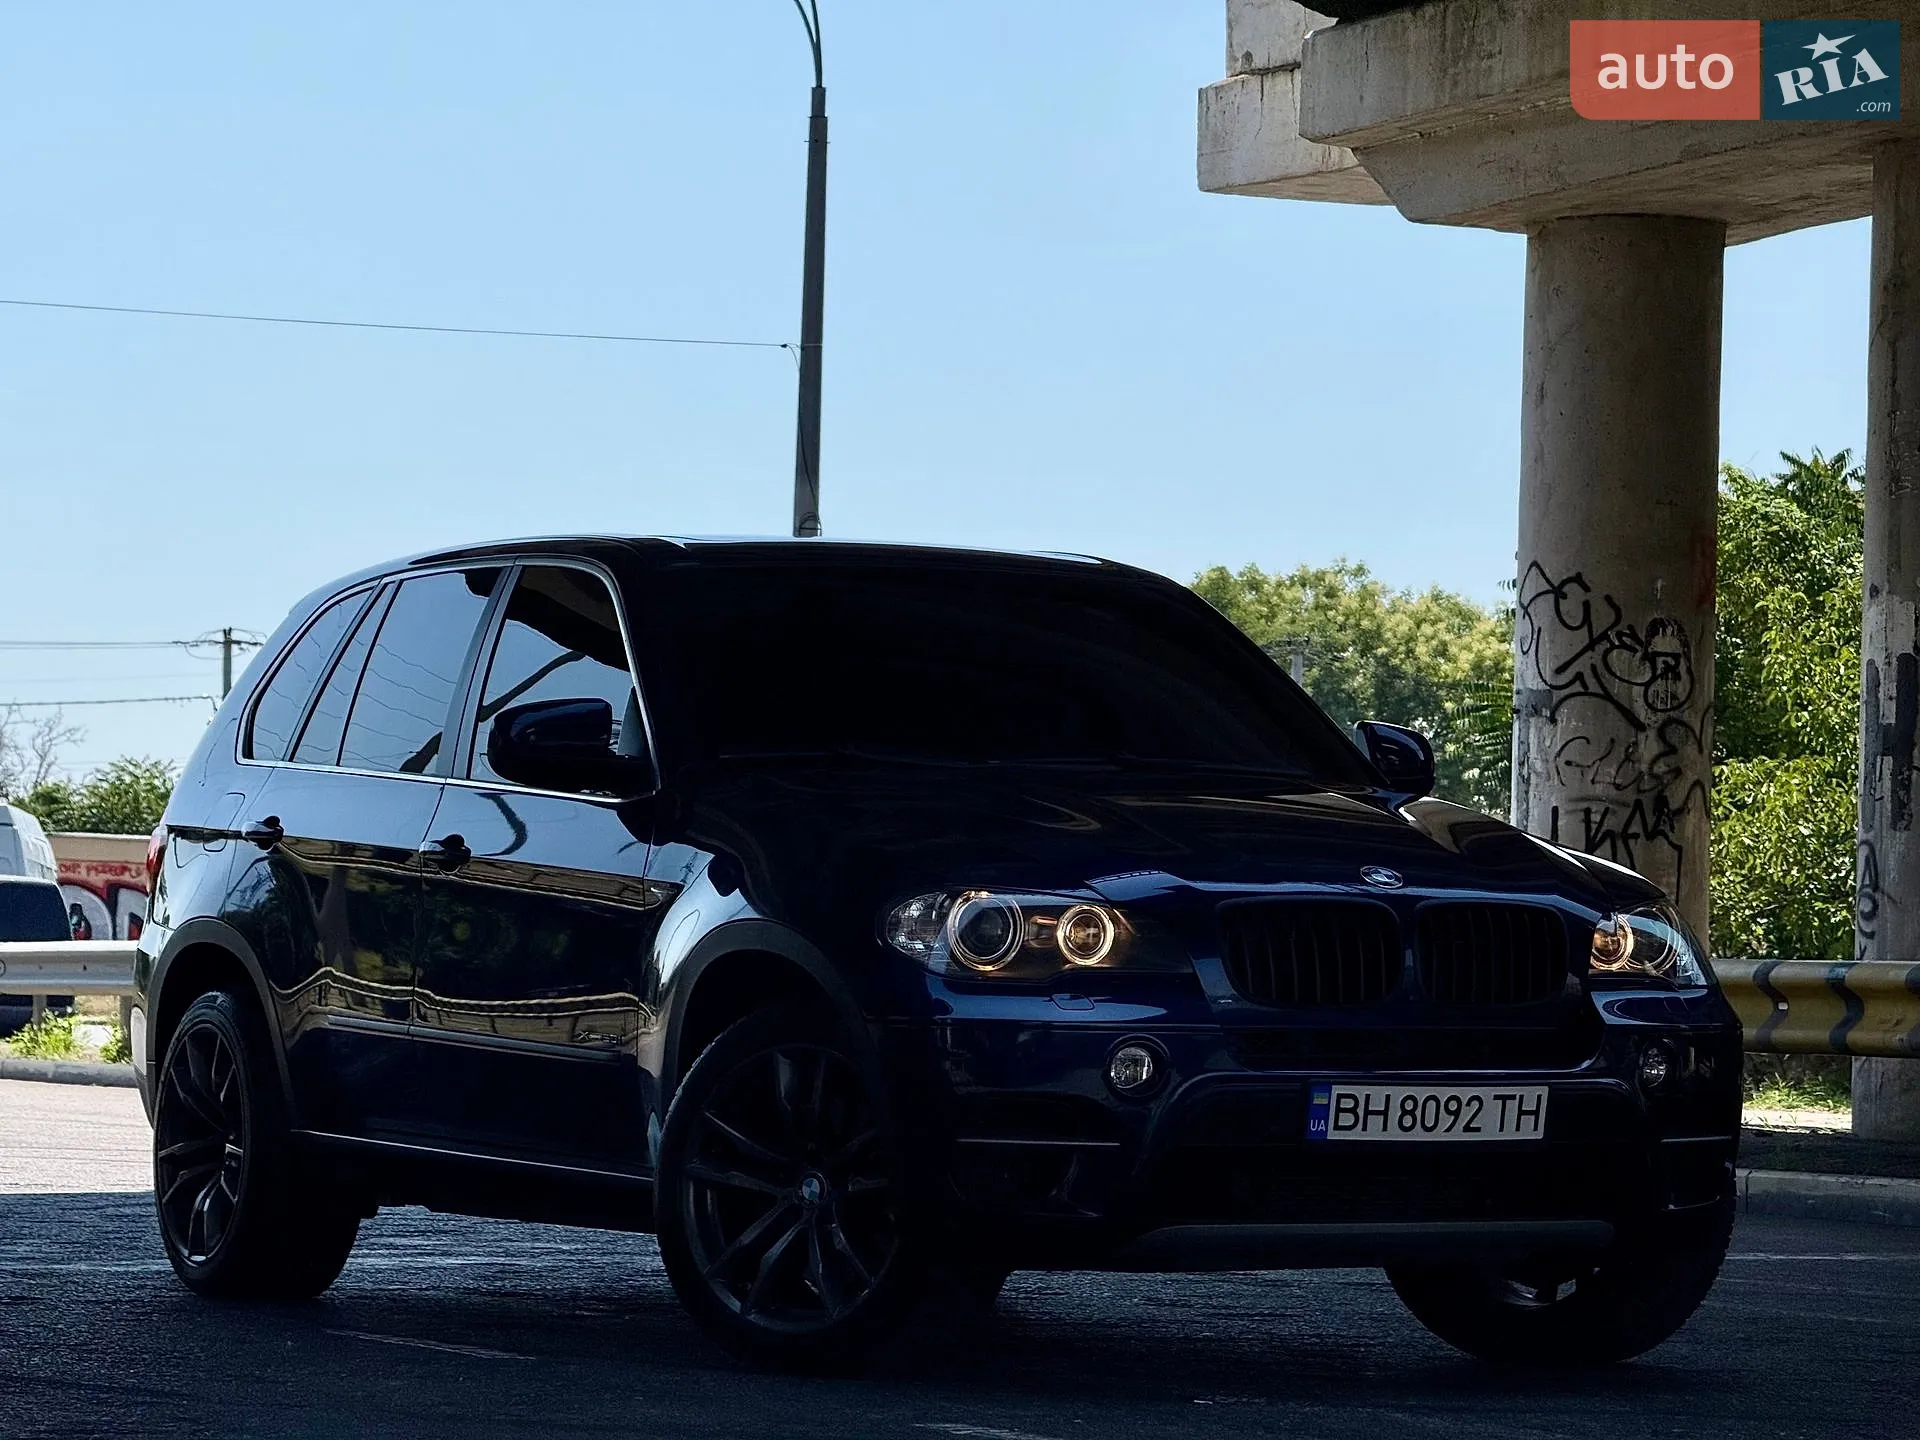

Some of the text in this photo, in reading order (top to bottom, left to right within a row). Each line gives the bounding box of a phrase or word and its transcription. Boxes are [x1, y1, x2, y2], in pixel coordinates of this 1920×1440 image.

[1310, 1119, 1326, 1132] UA
[1332, 1092, 1542, 1133] BH 8092 TH
